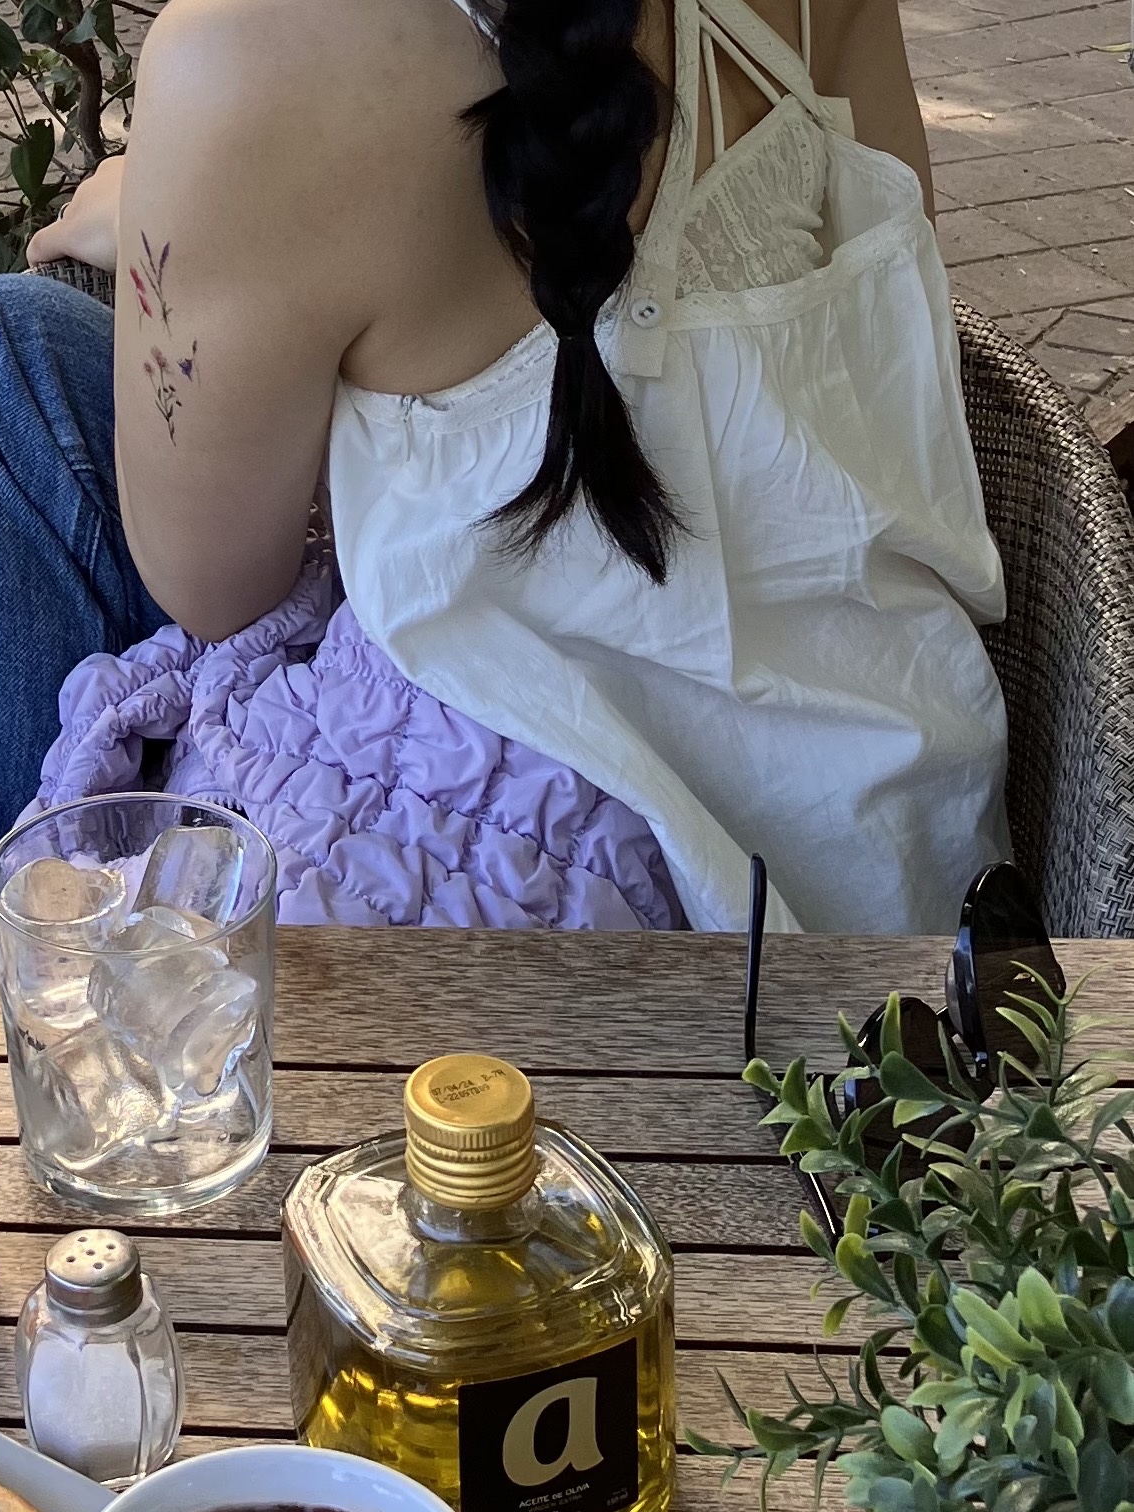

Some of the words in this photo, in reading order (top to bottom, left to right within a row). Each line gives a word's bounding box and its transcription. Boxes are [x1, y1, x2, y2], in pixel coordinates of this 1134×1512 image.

[502, 1376, 604, 1486] a
[519, 1494, 550, 1508] ACEITE
[566, 1483, 590, 1495] OLIVA
